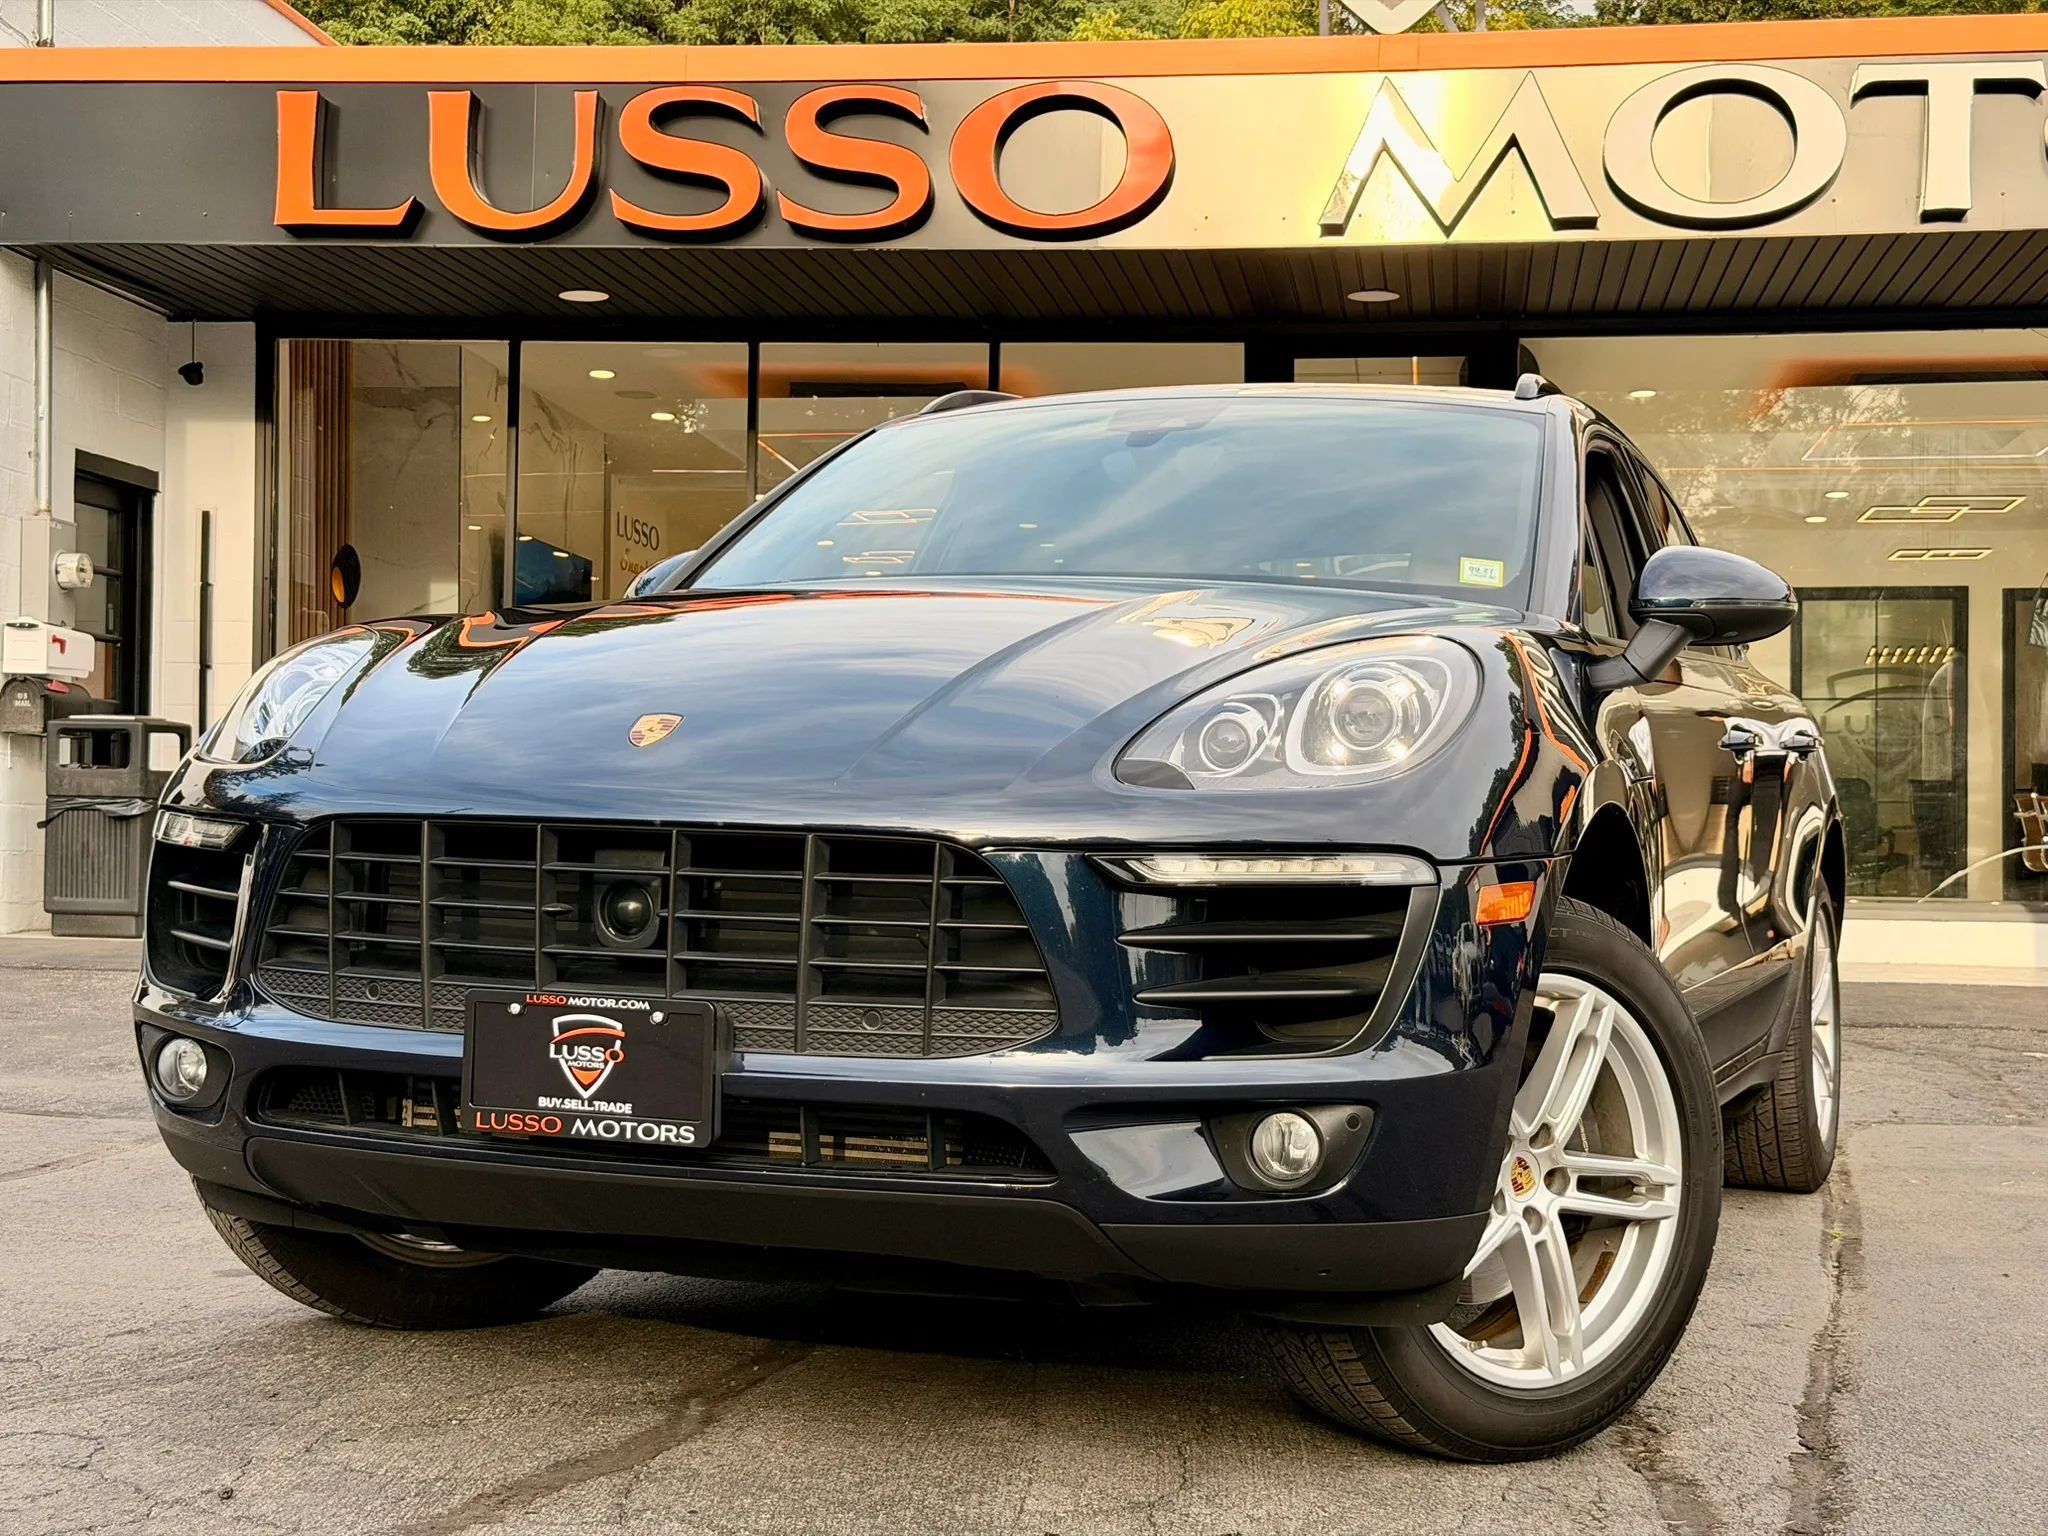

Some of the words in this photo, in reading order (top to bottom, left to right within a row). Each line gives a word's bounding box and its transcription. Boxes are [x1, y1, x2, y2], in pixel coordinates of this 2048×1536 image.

[273, 80, 1176, 241] LUSSO
[1318, 61, 2048, 237] MOT
[616, 511, 660, 551] LUSSO
[549, 1043, 625, 1064] LUSSO
[567, 1059, 605, 1069] MOTORS
[476, 1111, 563, 1134] LUSSO
[571, 1118, 695, 1144] MOTORS
